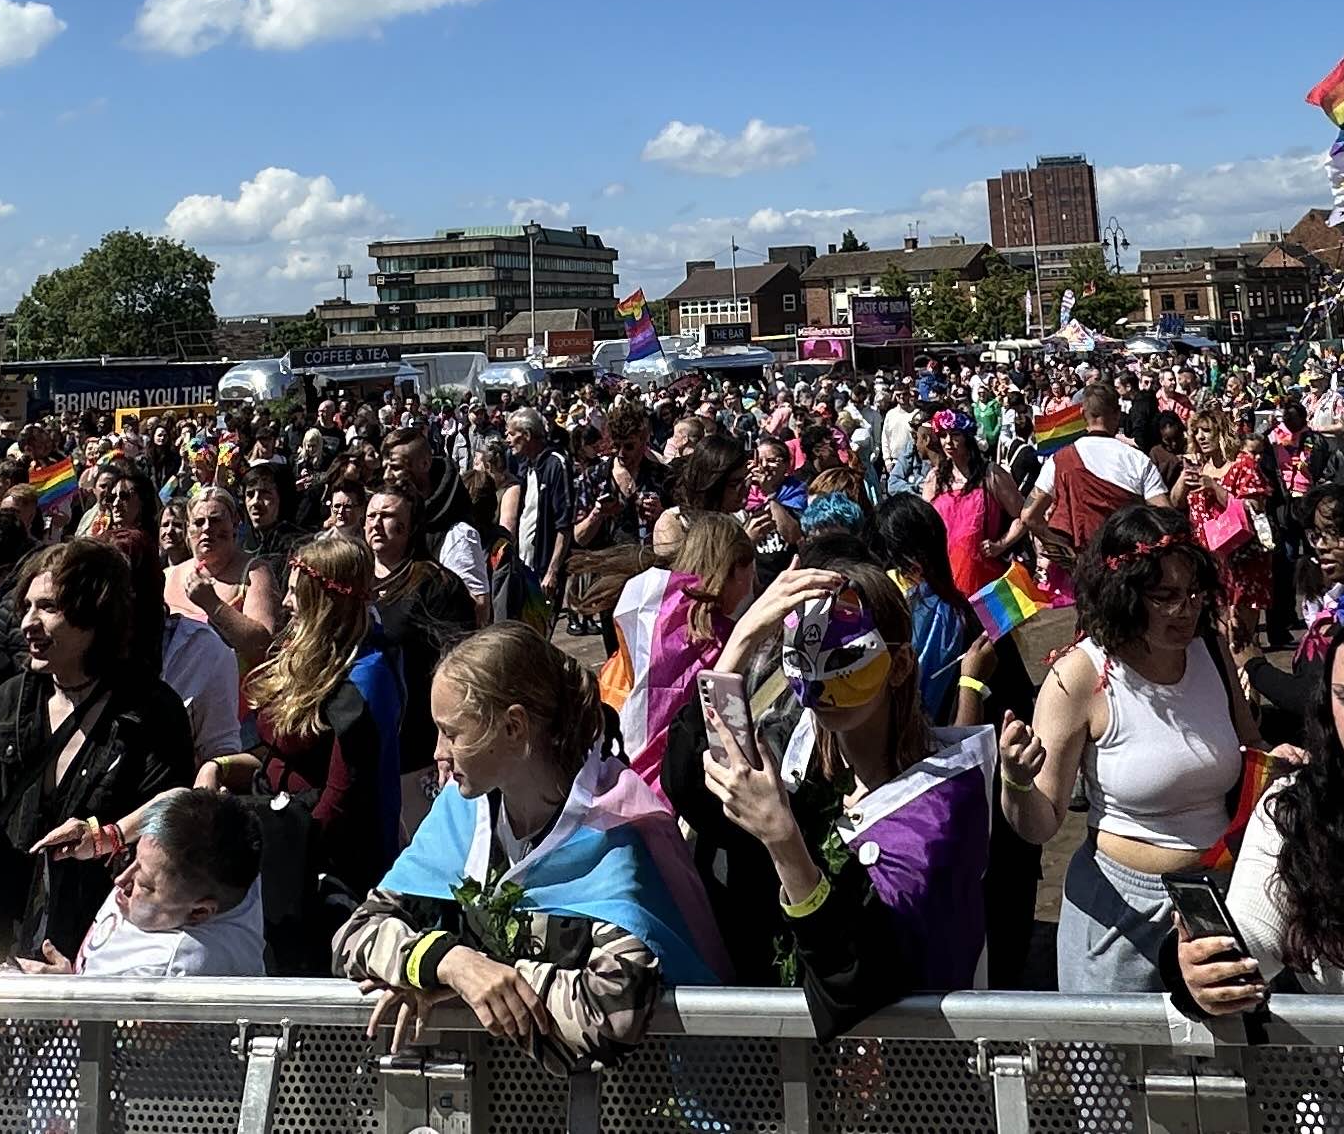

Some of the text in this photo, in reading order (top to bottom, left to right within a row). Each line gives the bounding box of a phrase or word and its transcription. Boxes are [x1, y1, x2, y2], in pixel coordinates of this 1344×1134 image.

[878, 301, 888, 314] OF
[712, 328, 745, 340] THE BAR
[304, 347, 390, 364] COFFEE & TEA
[54, 385, 213, 414] BRINGING YOU THE
